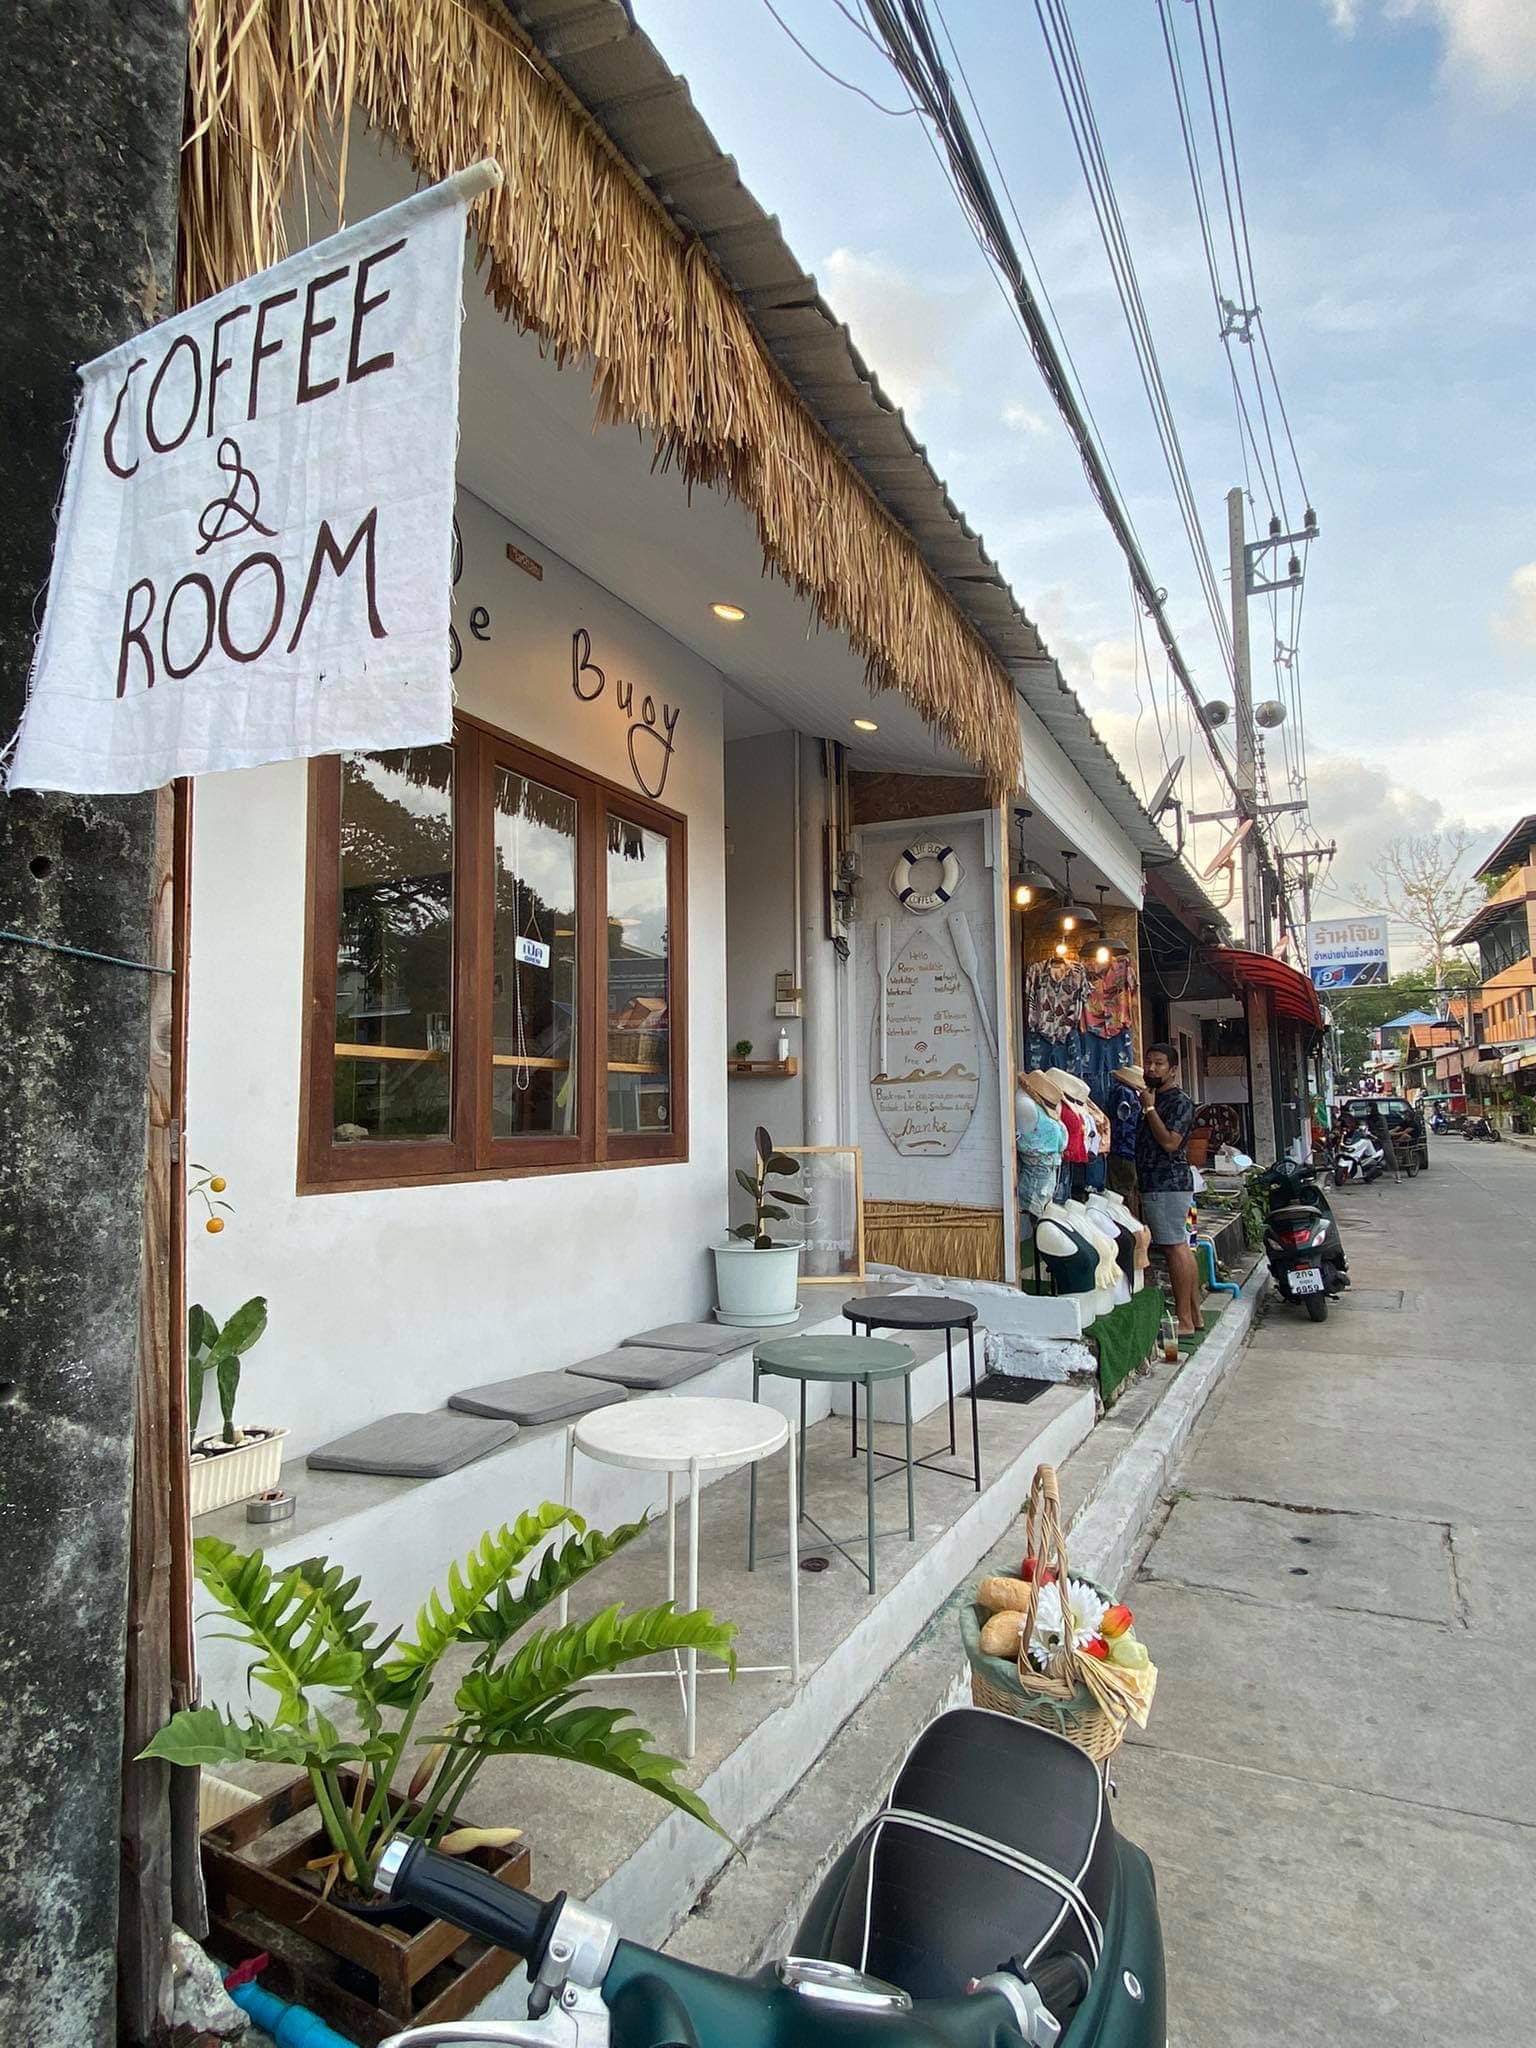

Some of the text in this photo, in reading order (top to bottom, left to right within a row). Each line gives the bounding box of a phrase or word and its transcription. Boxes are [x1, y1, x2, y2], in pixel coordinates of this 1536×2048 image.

[103, 238, 408, 479] COFFEE
[196, 437, 278, 555] &
[117, 507, 388, 699] ROOM
[573, 629, 680, 799] Buoy
[523, 941, 543, 959] เปิด
